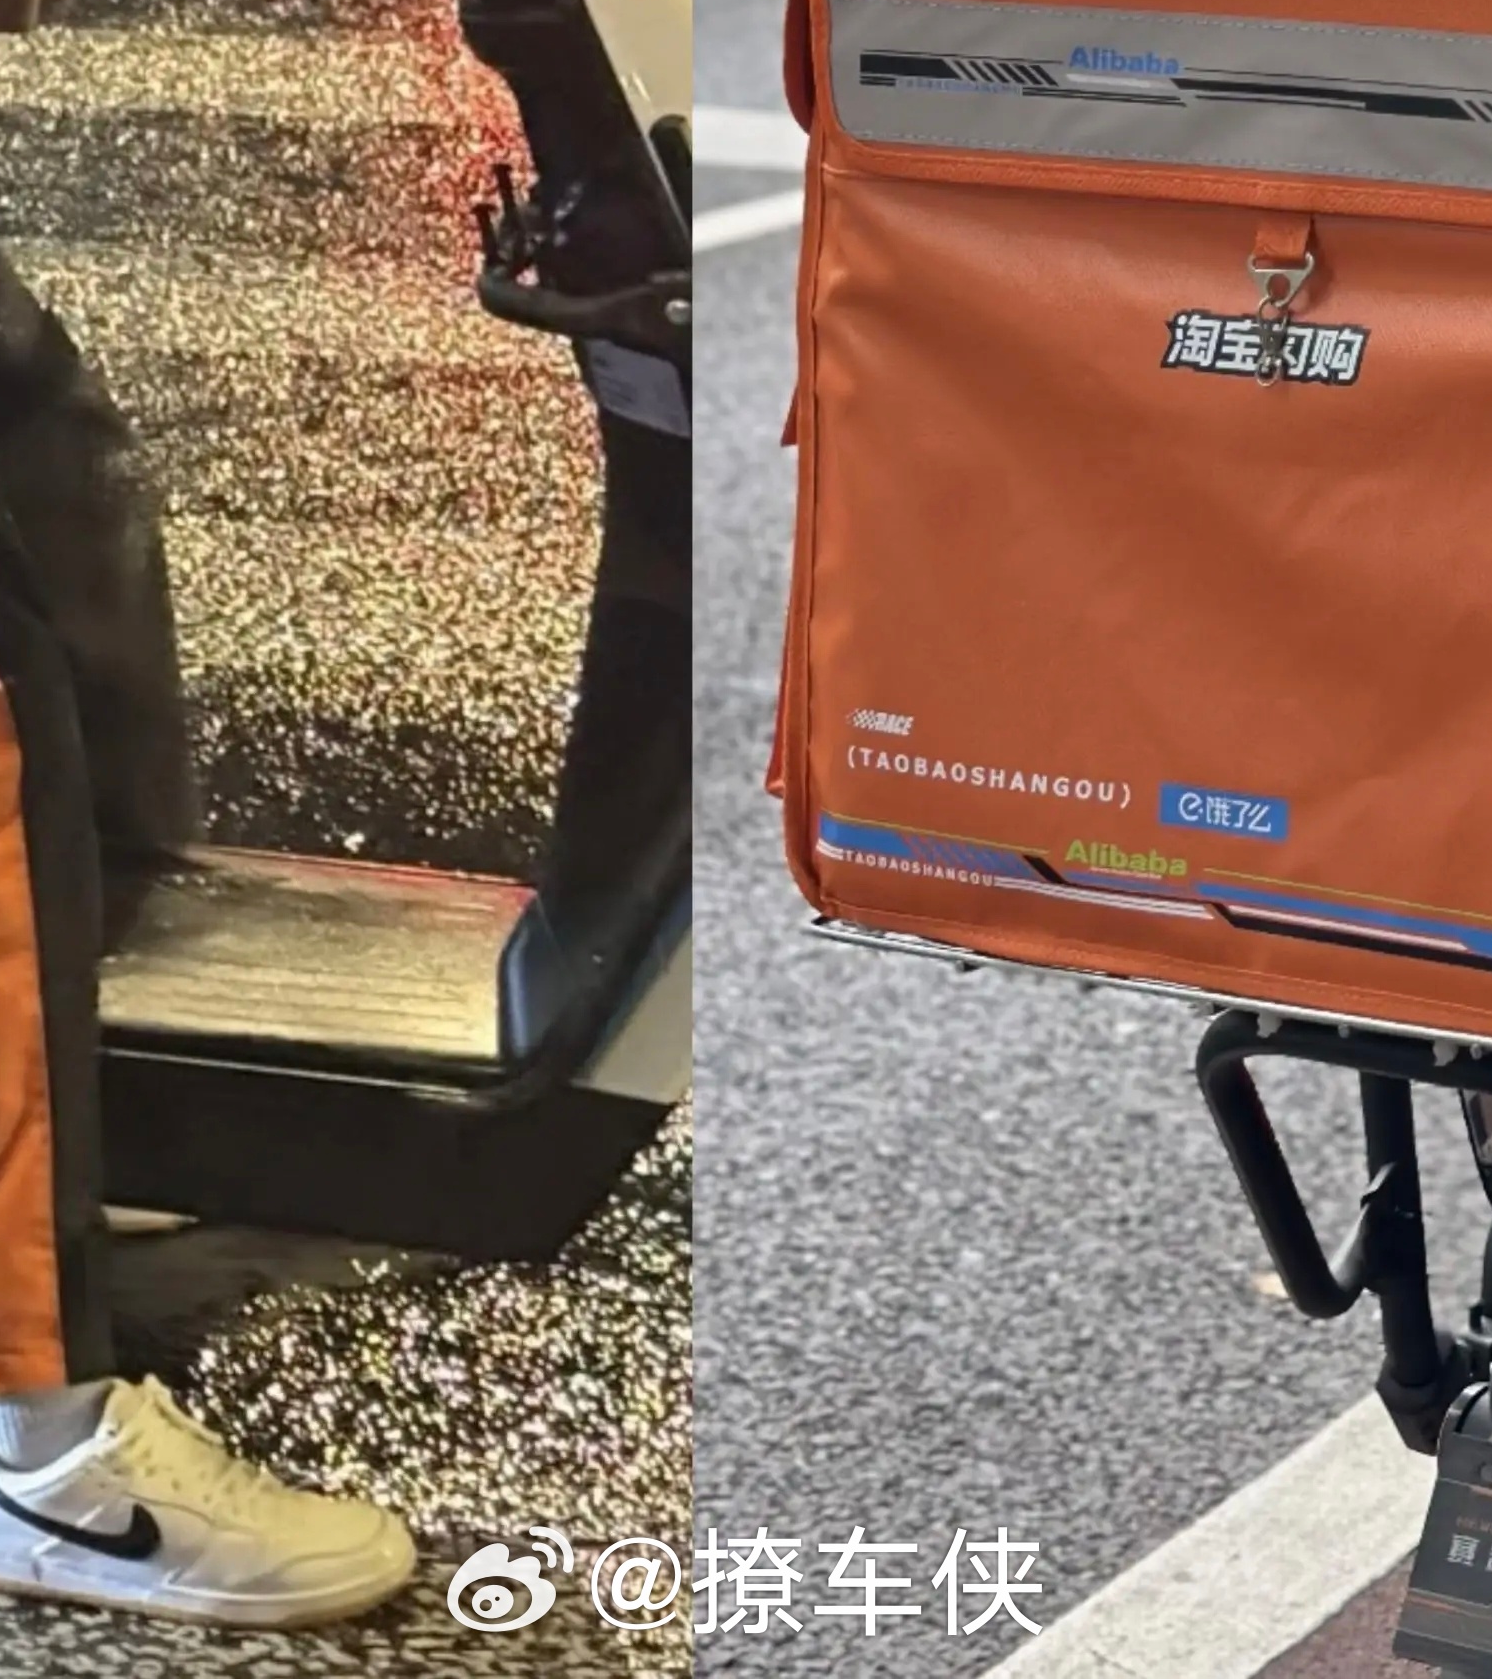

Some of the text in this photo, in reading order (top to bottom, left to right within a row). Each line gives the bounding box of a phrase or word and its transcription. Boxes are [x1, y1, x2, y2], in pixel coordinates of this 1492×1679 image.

[1069, 45, 1180, 75] Alibaba
[847, 745, 1131, 808] (TAOBAOSHANGOU)
[1066, 839, 1187, 877] Alibaba
